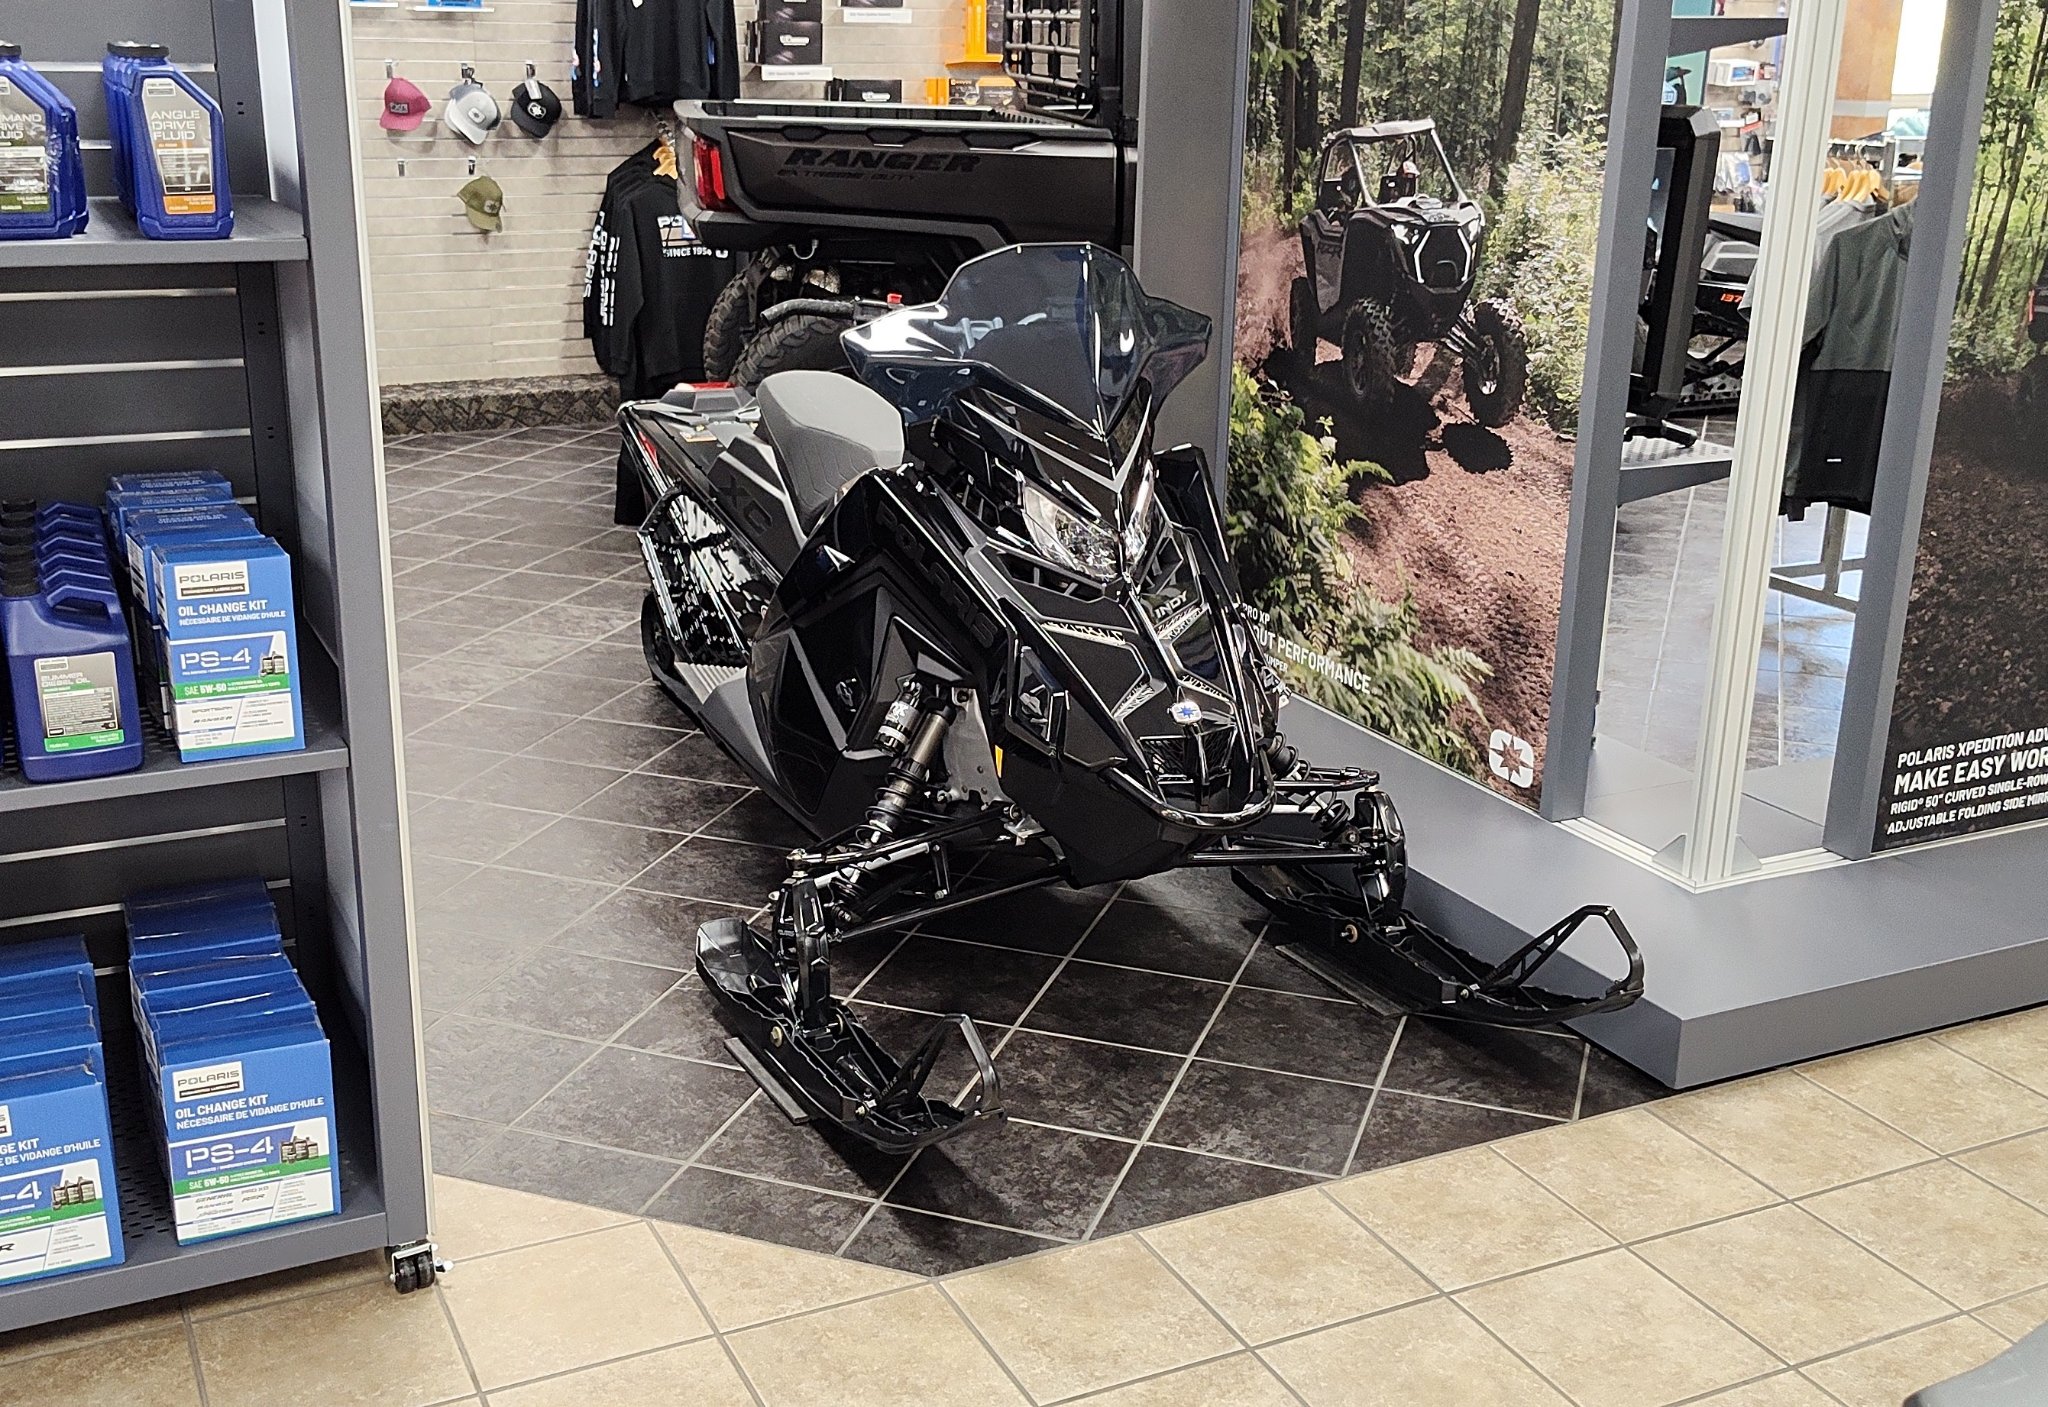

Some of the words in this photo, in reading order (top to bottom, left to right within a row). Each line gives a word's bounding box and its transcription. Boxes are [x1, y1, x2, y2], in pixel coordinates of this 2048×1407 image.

[151, 109, 201, 120] ANGLE
[0, 131, 24, 139] UID
[152, 120, 196, 131] DRIVE
[153, 130, 196, 141] FLUID
[784, 149, 981, 173] RANGER
[663, 246, 691, 258] SINCE
[179, 571, 245, 584] POLARIS
[875, 500, 998, 648] POLARIS
[178, 605, 198, 617] OIL
[199, 601, 248, 615] CHANGE
[249, 599, 268, 611] KIT
[1154, 591, 1188, 619] INDY
[222, 615, 232, 623] DE
[232, 613, 260, 622] VIDANGE
[261, 610, 286, 619] D'HUILE
[1259, 611, 1270, 625] XP
[180, 647, 252, 670] PS-4
[1264, 653, 1288, 672] UMPER
[1277, 636, 1372, 695] PERFORMANCE
[184, 685, 200, 696] SAE
[1897, 744, 1955, 769] POLARIS
[1956, 731, 2025, 758] XPEDITION
[1893, 764, 1952, 796] MAKE
[1953, 754, 2007, 784] EASY
[2010, 745, 2048, 773] WOR
[1944, 785, 1986, 804] CURVED
[1886, 809, 1957, 835] ADJUSTABLE
[1957, 800, 2001, 821] FOLDING
[2002, 795, 2026, 811] SIDE
[177, 1069, 240, 1087] POLARIS
[175, 1108, 195, 1120] OIL
[197, 1097, 248, 1115] CHANGE
[249, 1093, 269, 1106] KIT
[236, 1110, 249, 1120] DE
[249, 1103, 289, 1117] VIDANGE
[290, 1096, 325, 1110] D'HUILE
[5, 1154, 19, 1165] DE
[20, 1146, 63, 1162] VIDANGE
[63, 1138, 101, 1154] D'HUILE
[18, 1138, 40, 1151] KIT
[185, 1136, 274, 1169] PS-4
[189, 1178, 203, 1190] SAE
